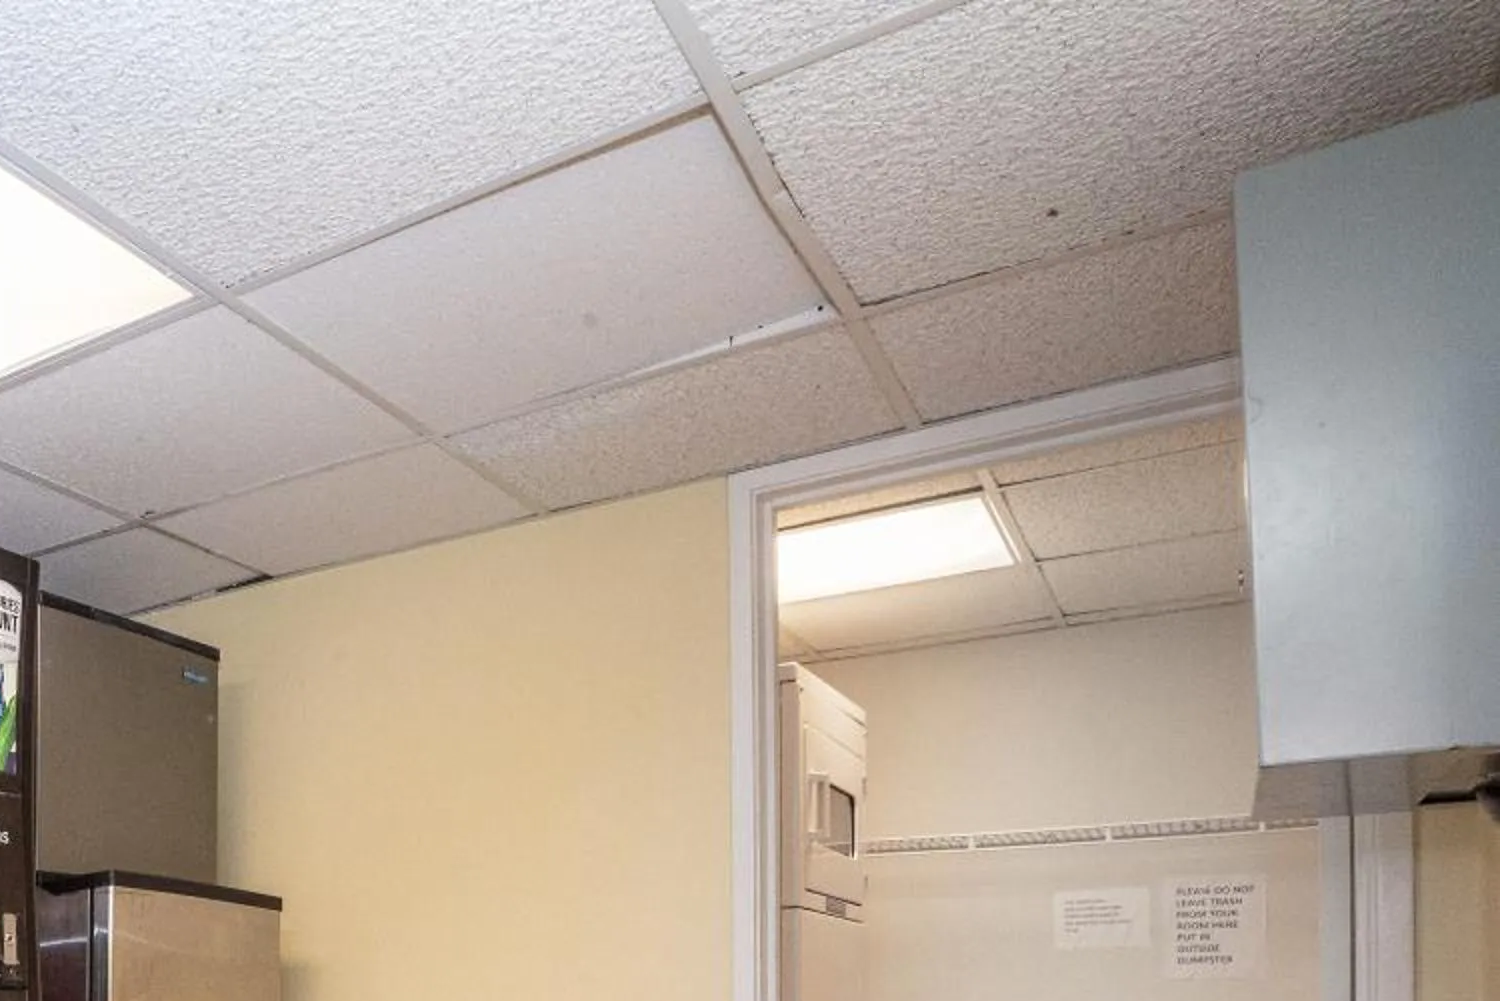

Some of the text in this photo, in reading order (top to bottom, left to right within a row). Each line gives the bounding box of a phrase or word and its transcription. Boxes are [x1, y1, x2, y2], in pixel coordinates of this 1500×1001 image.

[1214, 885, 1230, 894] DO
[1233, 884, 1255, 893] NOT
[1176, 897, 1243, 907] LEAVE TRASH
[1177, 933, 1197, 941] PUT
